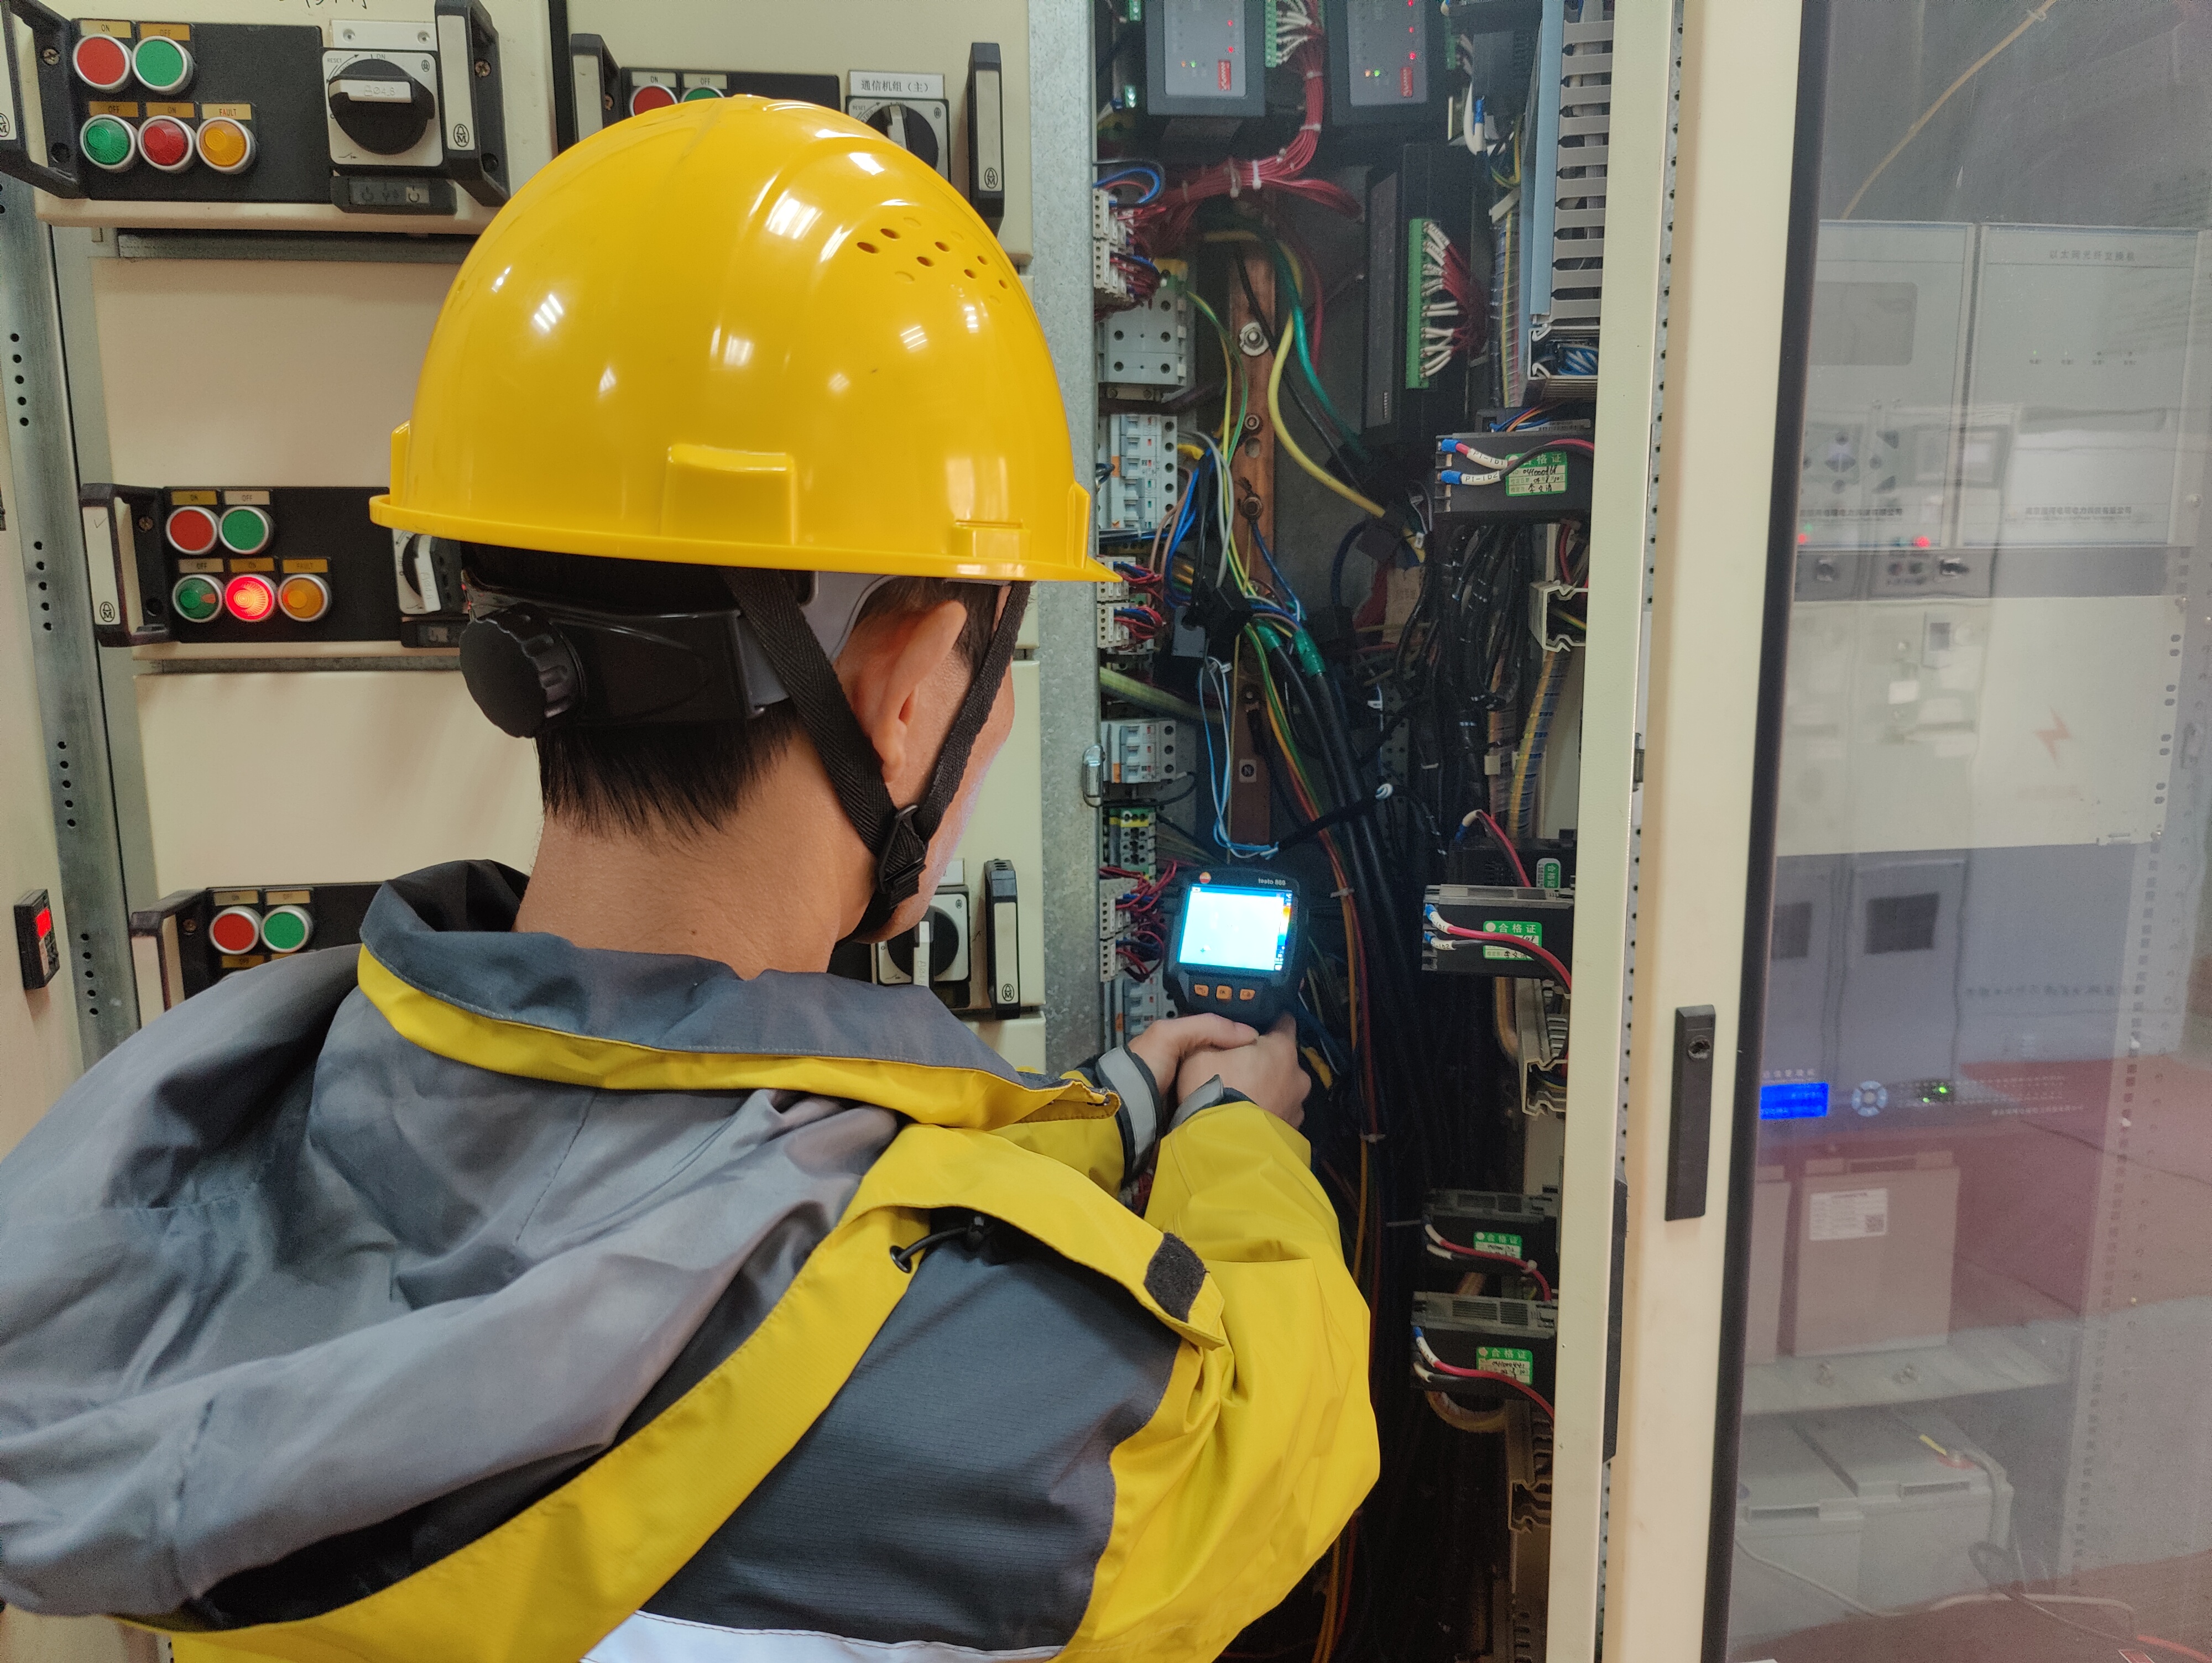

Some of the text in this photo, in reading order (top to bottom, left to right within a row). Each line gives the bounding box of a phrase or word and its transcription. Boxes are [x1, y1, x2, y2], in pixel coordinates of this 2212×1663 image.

[101, 24, 110, 32] ON
[860, 80, 929, 93] 通信机组（主）
[108, 106, 120, 114] OFF
[219, 108, 237, 117] FAULT
[1498, 923, 1536, 934] 合格证
[1491, 1348, 1527, 1359] 合格证
